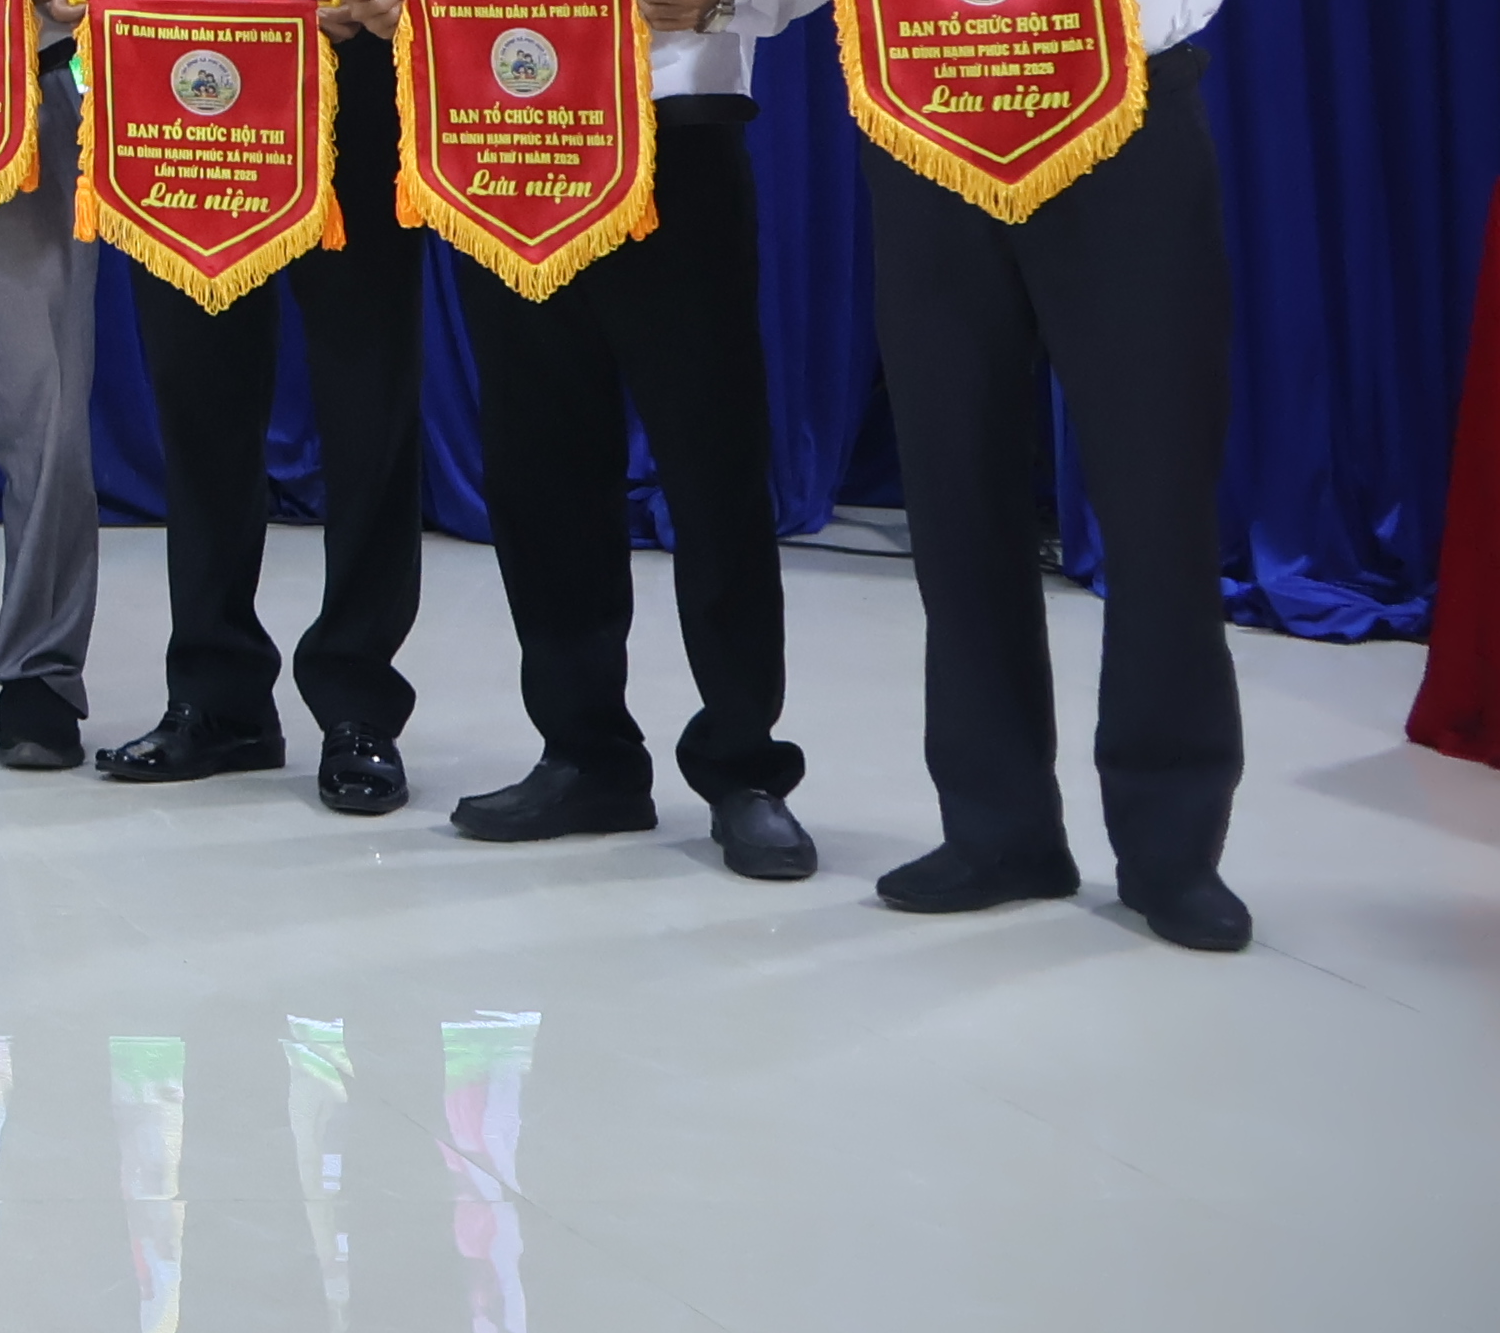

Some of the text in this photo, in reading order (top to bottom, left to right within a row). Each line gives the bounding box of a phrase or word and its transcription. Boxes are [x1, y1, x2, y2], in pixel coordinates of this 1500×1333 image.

[899, 11, 1080, 37] BAN TỔ CHỨC HỘI THI
[450, 101, 604, 128] BAN TỔ CHỨC HỘI THI
[921, 85, 1071, 118] Lưu niệm
[127, 118, 284, 146] BAN TỔ CHỨC HỘI THI
[141, 182, 271, 218] Lưu niệm
[467, 169, 592, 204] Lưu niệm
